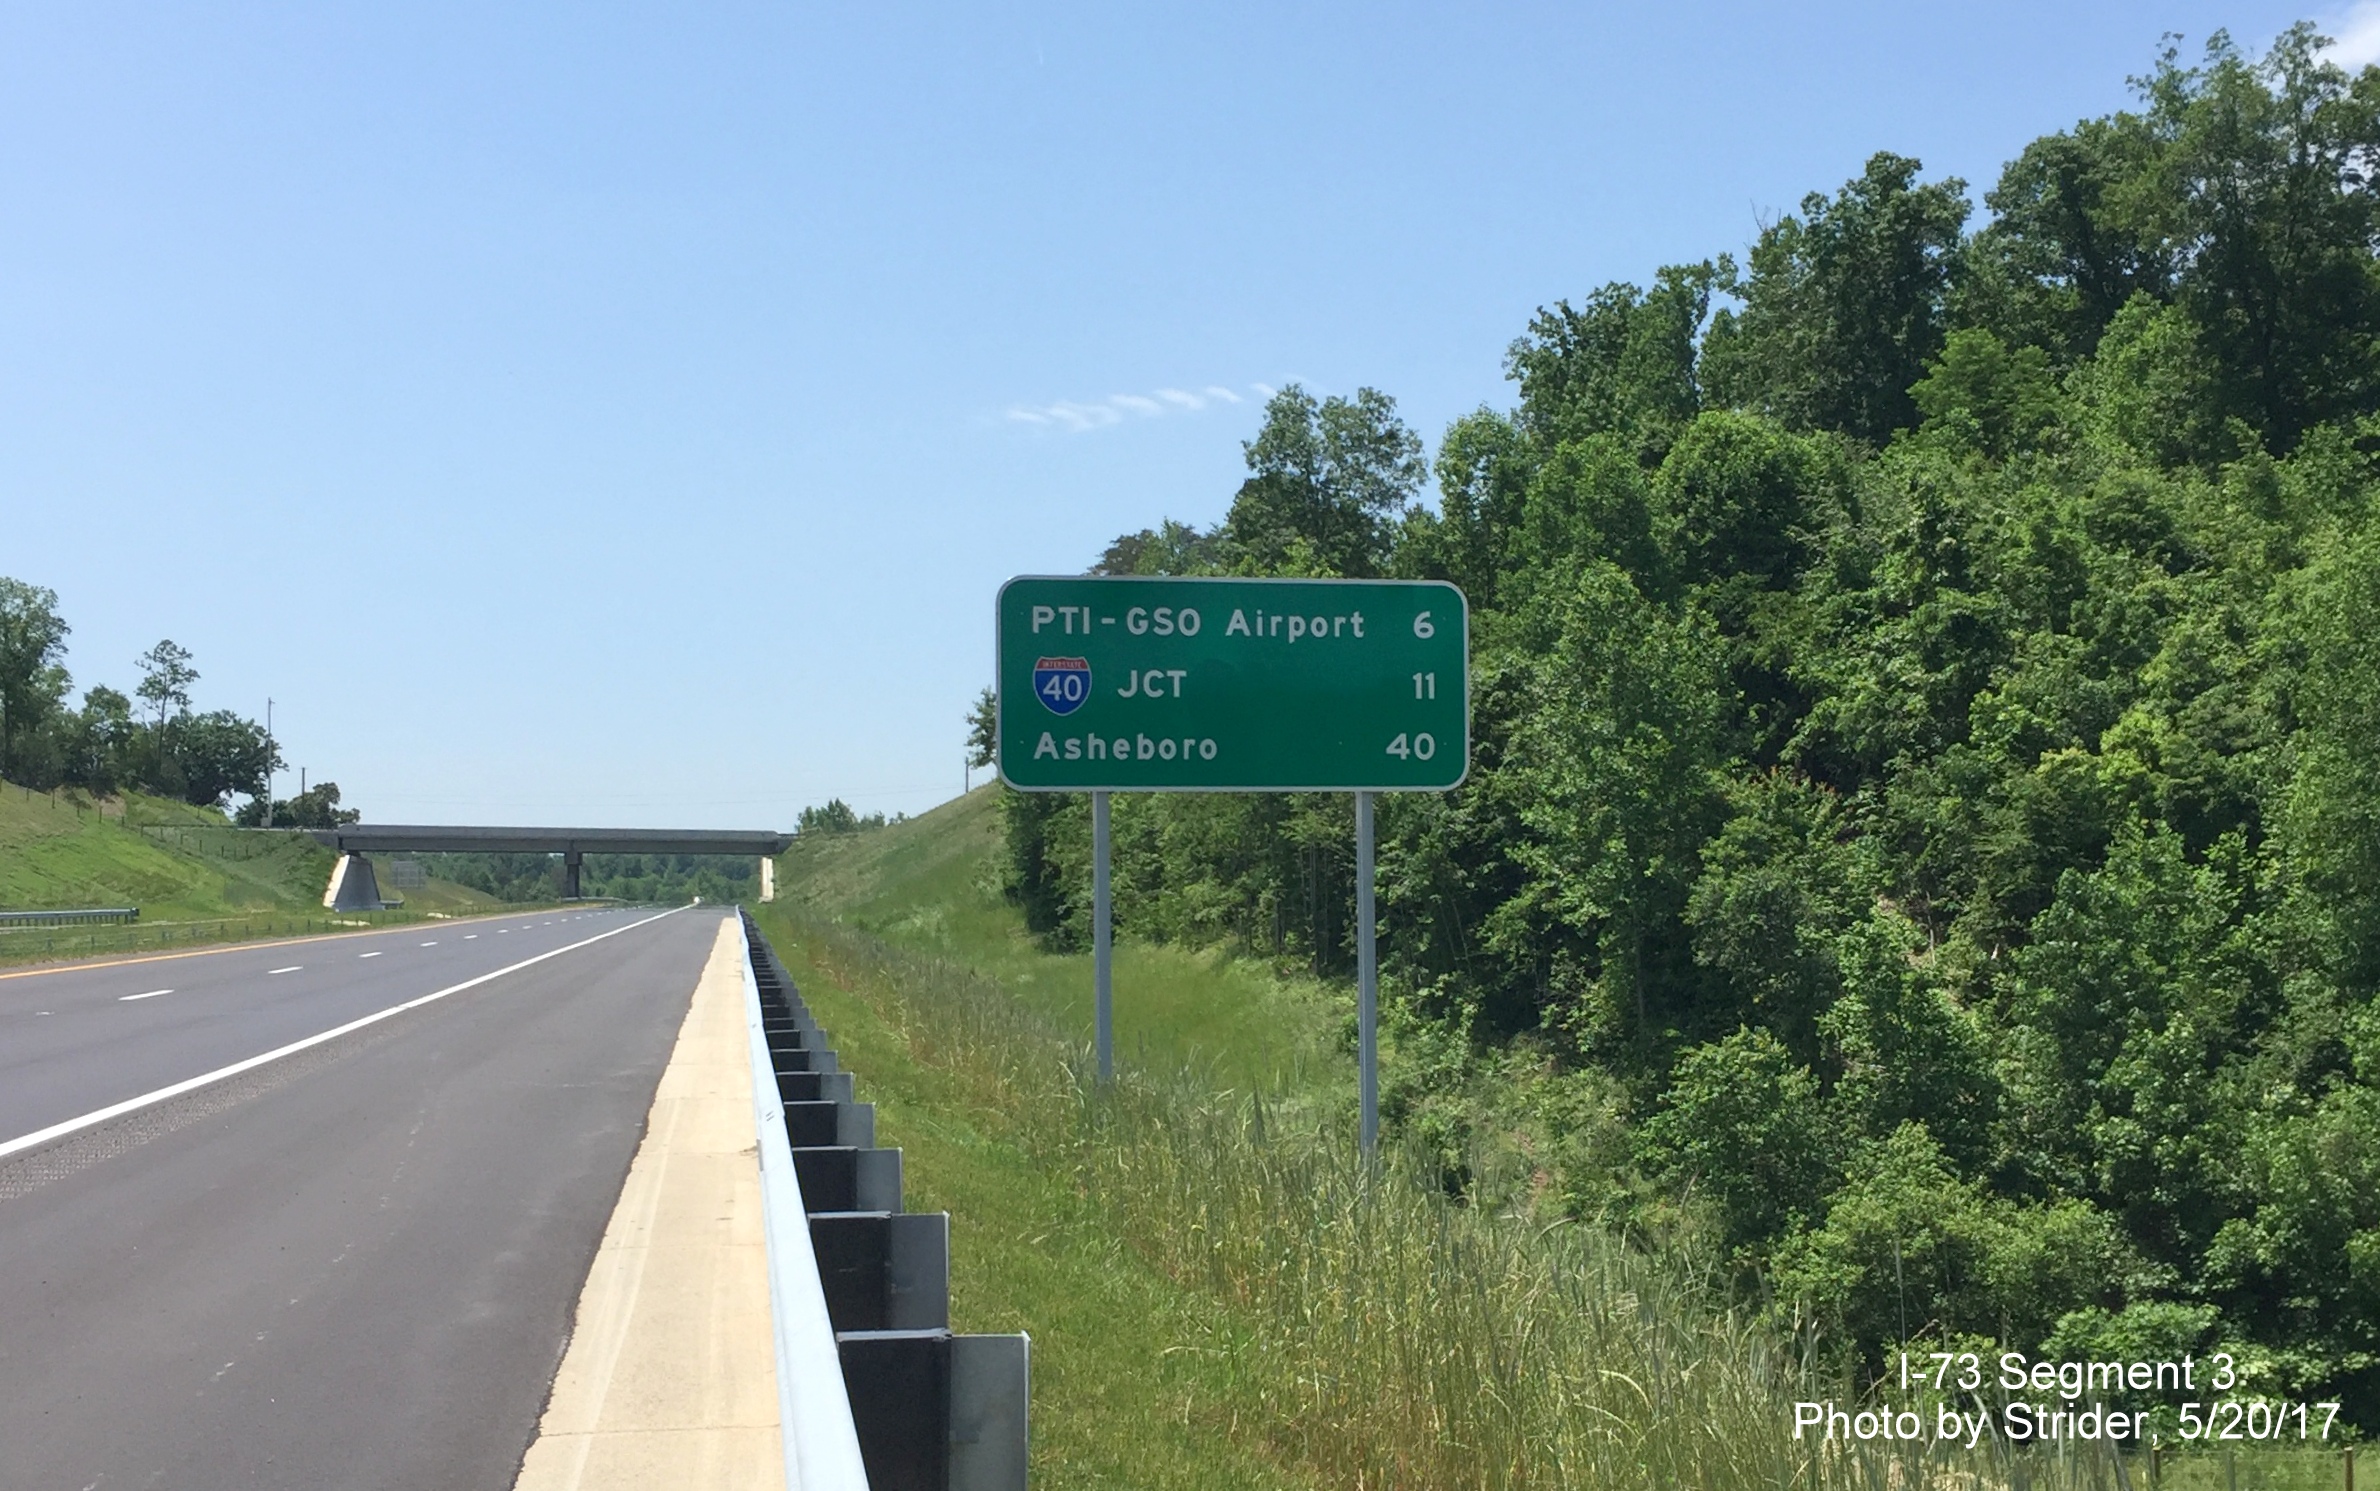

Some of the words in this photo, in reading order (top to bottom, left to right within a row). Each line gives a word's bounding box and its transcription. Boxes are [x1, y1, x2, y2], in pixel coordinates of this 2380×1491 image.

[1226, 609, 1364, 643] Airport
[1413, 611, 1434, 639] 6
[1043, 675, 1082, 701] 40
[1118, 670, 1186, 697] JCT
[1413, 672, 1435, 699] 11
[1034, 732, 1217, 759] Asheboro
[1386, 733, 1435, 760] 40
